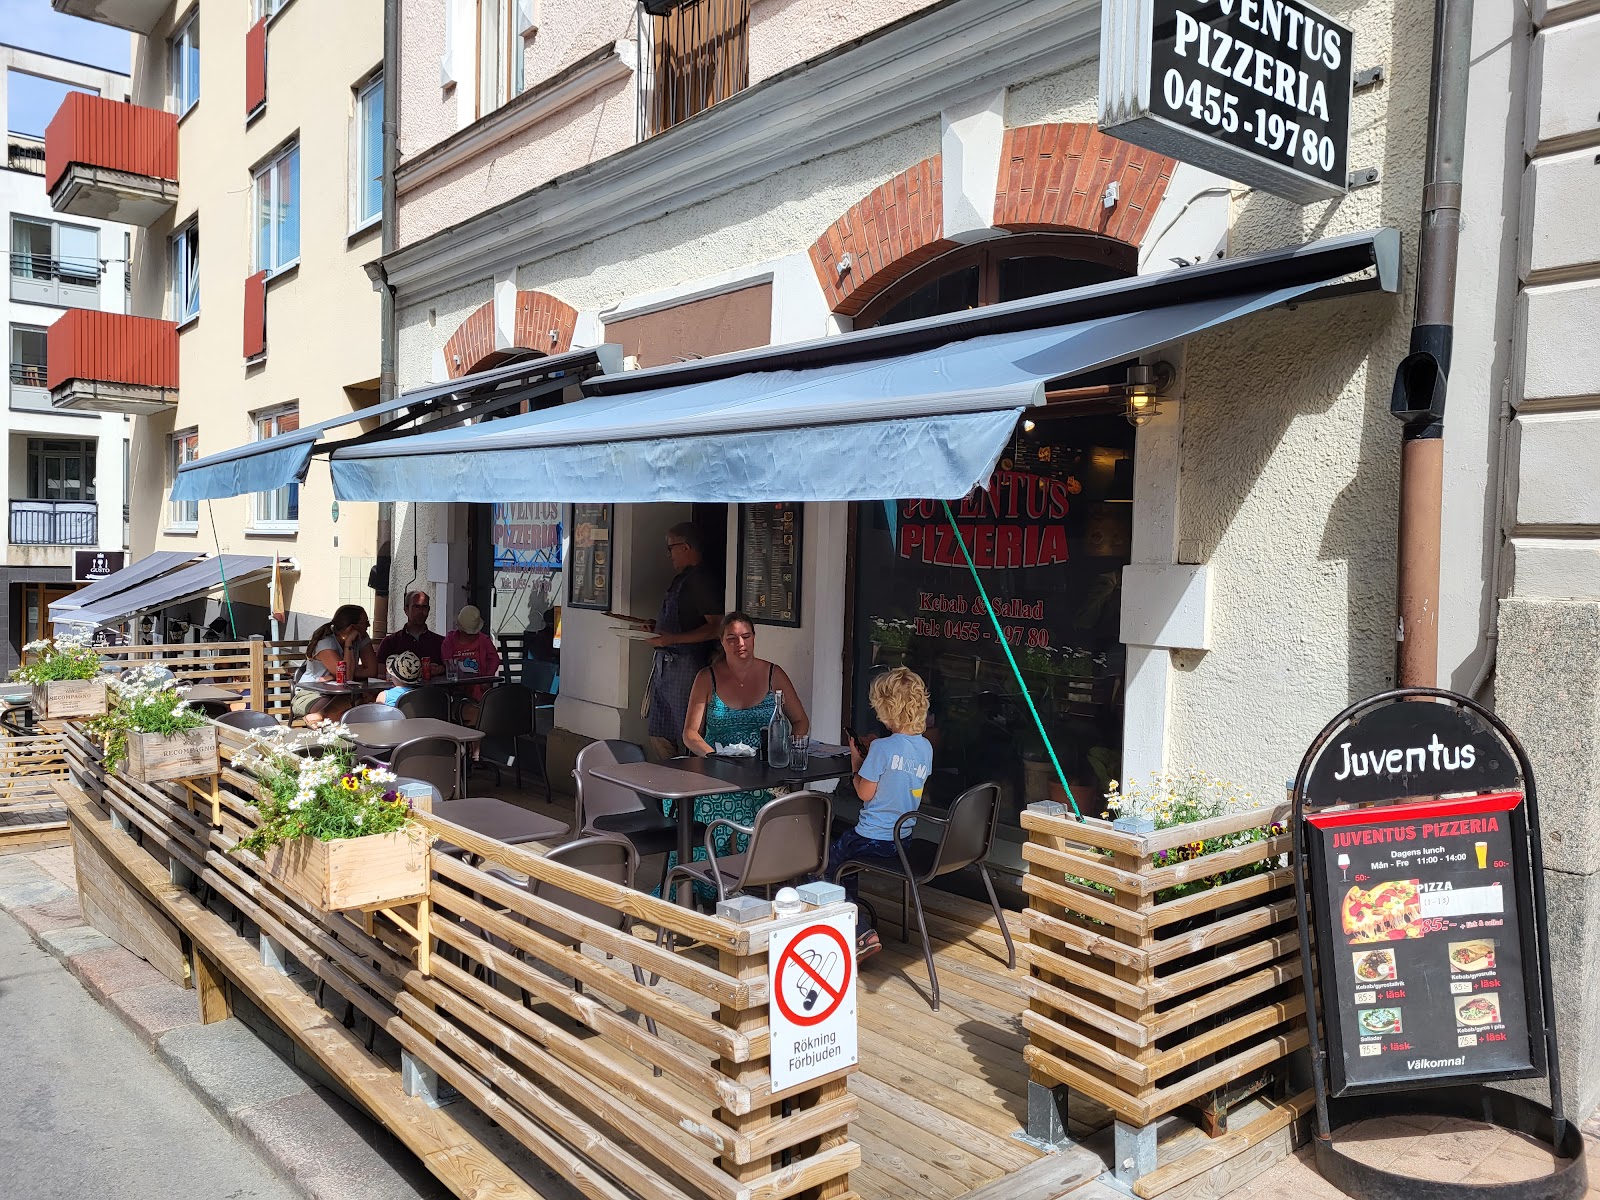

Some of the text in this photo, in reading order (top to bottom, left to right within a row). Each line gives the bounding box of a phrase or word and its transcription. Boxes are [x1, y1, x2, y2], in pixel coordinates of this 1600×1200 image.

[1197, 0, 1341, 70] ENTUS
[1174, 10, 1330, 122] PIZZERIA
[494, 524, 558, 551] PIZZERIA
[900, 524, 1069, 569] PIZZERIA
[919, 592, 1044, 620] Kebab & Sallad
[914, 616, 940, 637] Tel:
[944, 620, 980, 641] 0455
[1028, 628, 1049, 648] 80
[49, 693, 92, 701] RECOMPAGNO
[163, 745, 215, 756] RECOMPAGNO
[1334, 734, 1476, 781] Juventus
[1332, 817, 1499, 848] JUVENTUS PIZZERIA
[1371, 860, 1389, 870] Mån
[1396, 859, 1410, 868] Fre
[1417, 856, 1439, 866] 11:00
[1445, 853, 1467, 862] 14:00
[1391, 846, 1446, 860] Dagens lunch
[1416, 881, 1453, 893] PIZZA
[1421, 917, 1457, 934] 85:-
[1480, 979, 1501, 988] läsk
[1386, 989, 1406, 999] läsk
[793, 1032, 836, 1054] Rökning
[1486, 1032, 1507, 1041] läsk
[1390, 1042, 1411, 1051] läsk
[789, 1045, 841, 1072] Förbjuden
[1407, 1055, 1466, 1070] Välkomna!
